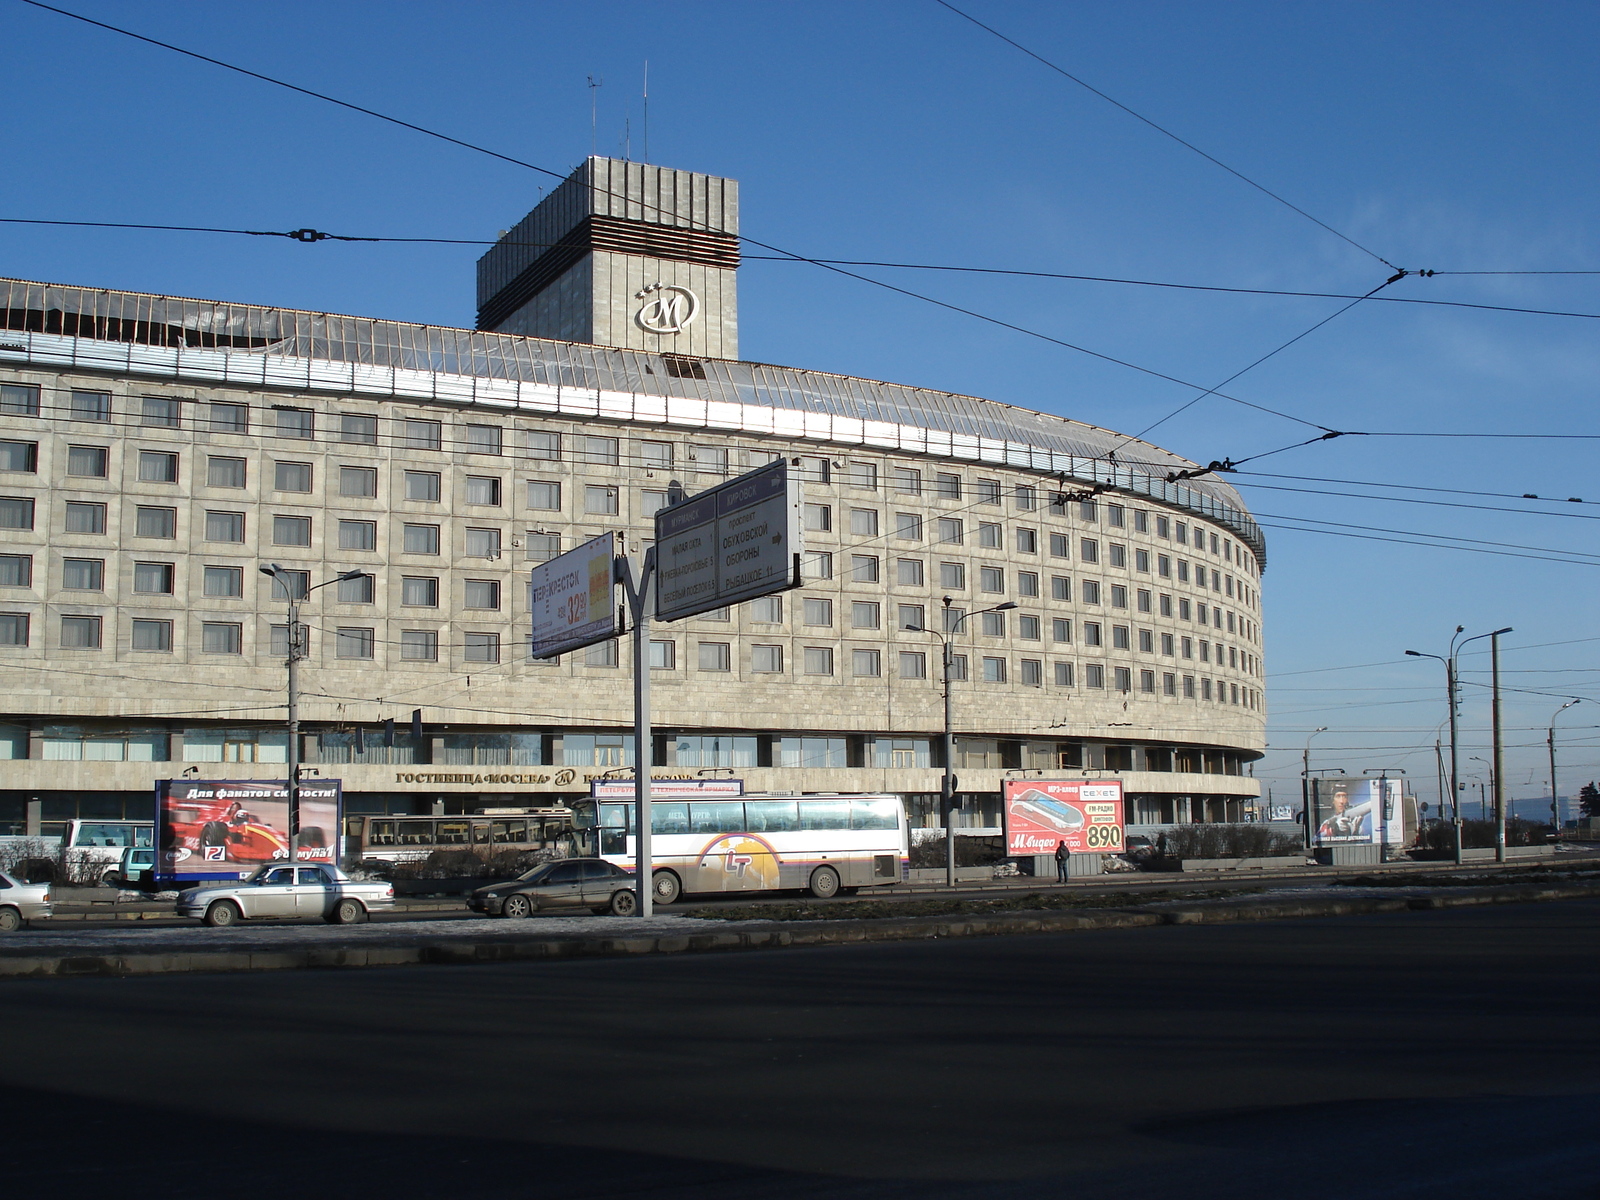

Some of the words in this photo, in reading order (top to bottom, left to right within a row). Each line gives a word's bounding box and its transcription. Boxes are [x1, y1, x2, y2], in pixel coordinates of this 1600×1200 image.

[726, 484, 758, 507] КИРОВСК
[671, 508, 700, 528] МУРМАНСК
[728, 511, 756, 531] проспект
[723, 521, 768, 549] ОБУХОВСКОЙ
[726, 546, 760, 567] ОБОРОНЫ
[533, 570, 580, 603] ПЕРЕКРЕСТОК
[725, 568, 762, 590] РЫБАЦКОЕ
[766, 565, 773, 577] 11
[567, 593, 580, 625] 32
[395, 773, 483, 785] ГОСТИНИЦА
[484, 773, 551, 784] «МОСКВА»
[186, 789, 213, 799] Для
[216, 788, 271, 799] фанатов
[1088, 805, 1114, 813] FM-РАДИО
[1088, 825, 1121, 847] 890
